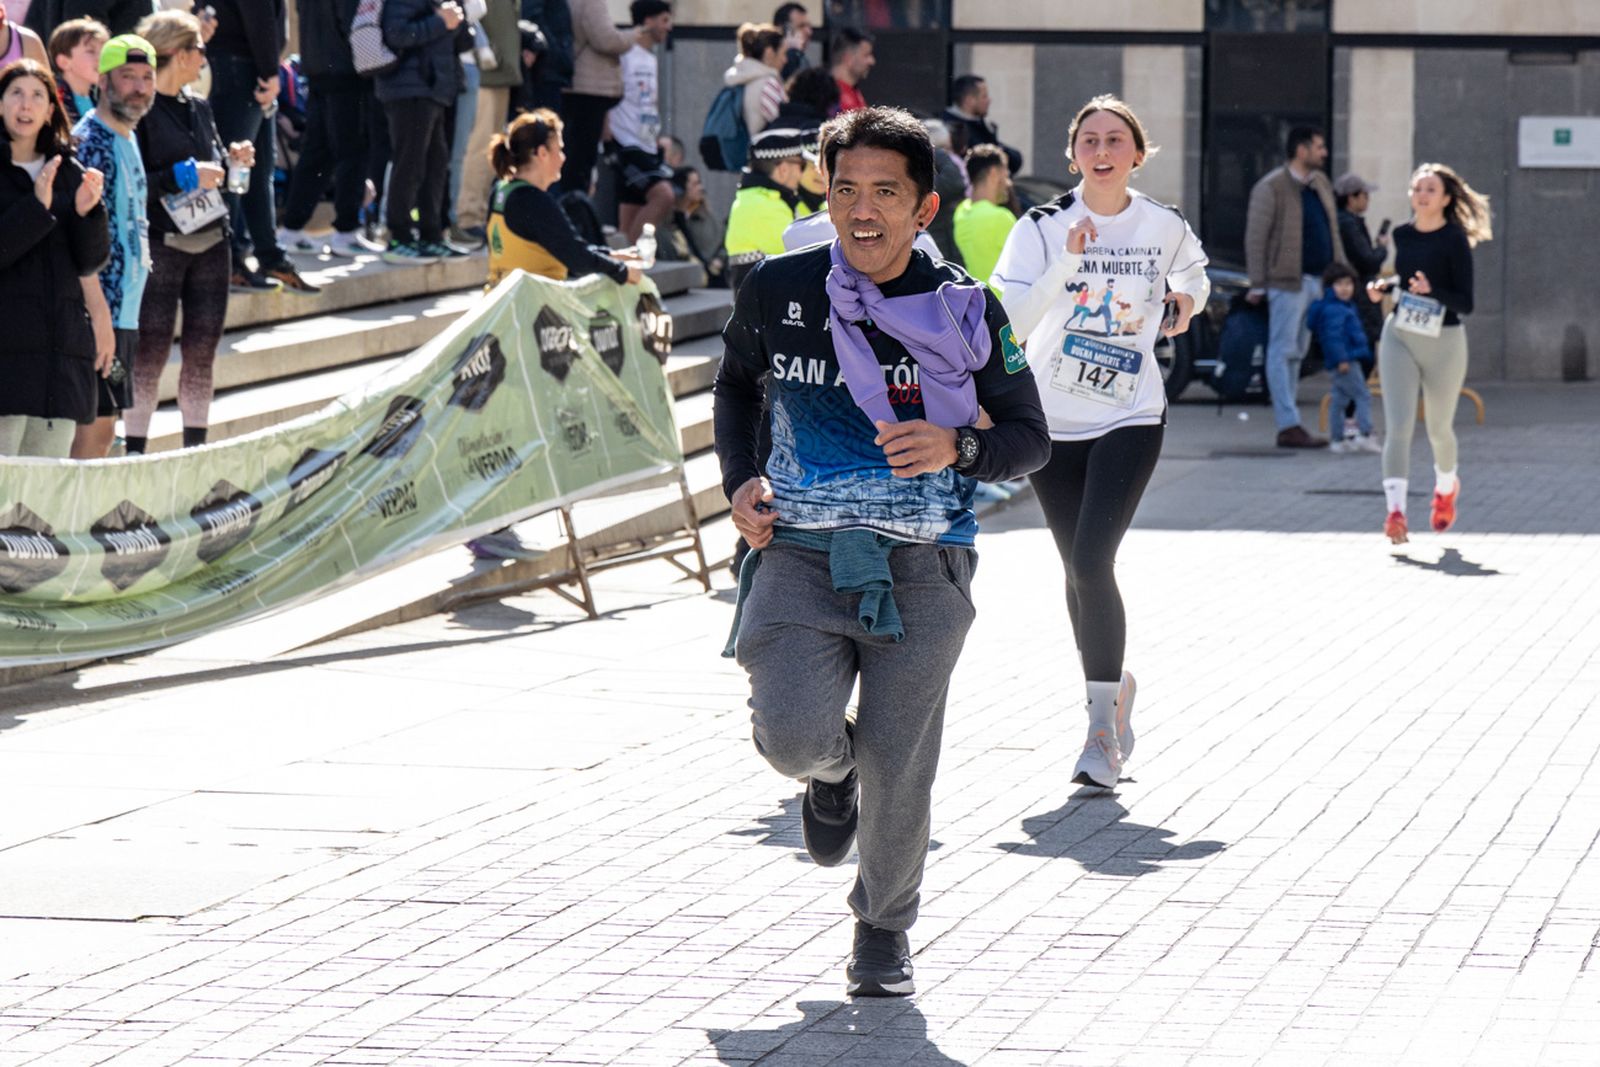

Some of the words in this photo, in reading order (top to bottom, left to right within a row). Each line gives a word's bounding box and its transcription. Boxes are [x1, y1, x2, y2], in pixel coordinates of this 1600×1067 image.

[185, 195, 214, 219] 791
[1117, 247, 1162, 257] CAMINATA
[1101, 260, 1144, 276] MUERTE
[1070, 345, 1094, 361] BUENA
[1093, 350, 1121, 367] MUERTE
[1106, 344, 1135, 360] CAMINATA
[772, 352, 826, 385] SAN
[1077, 361, 1119, 390] 147
